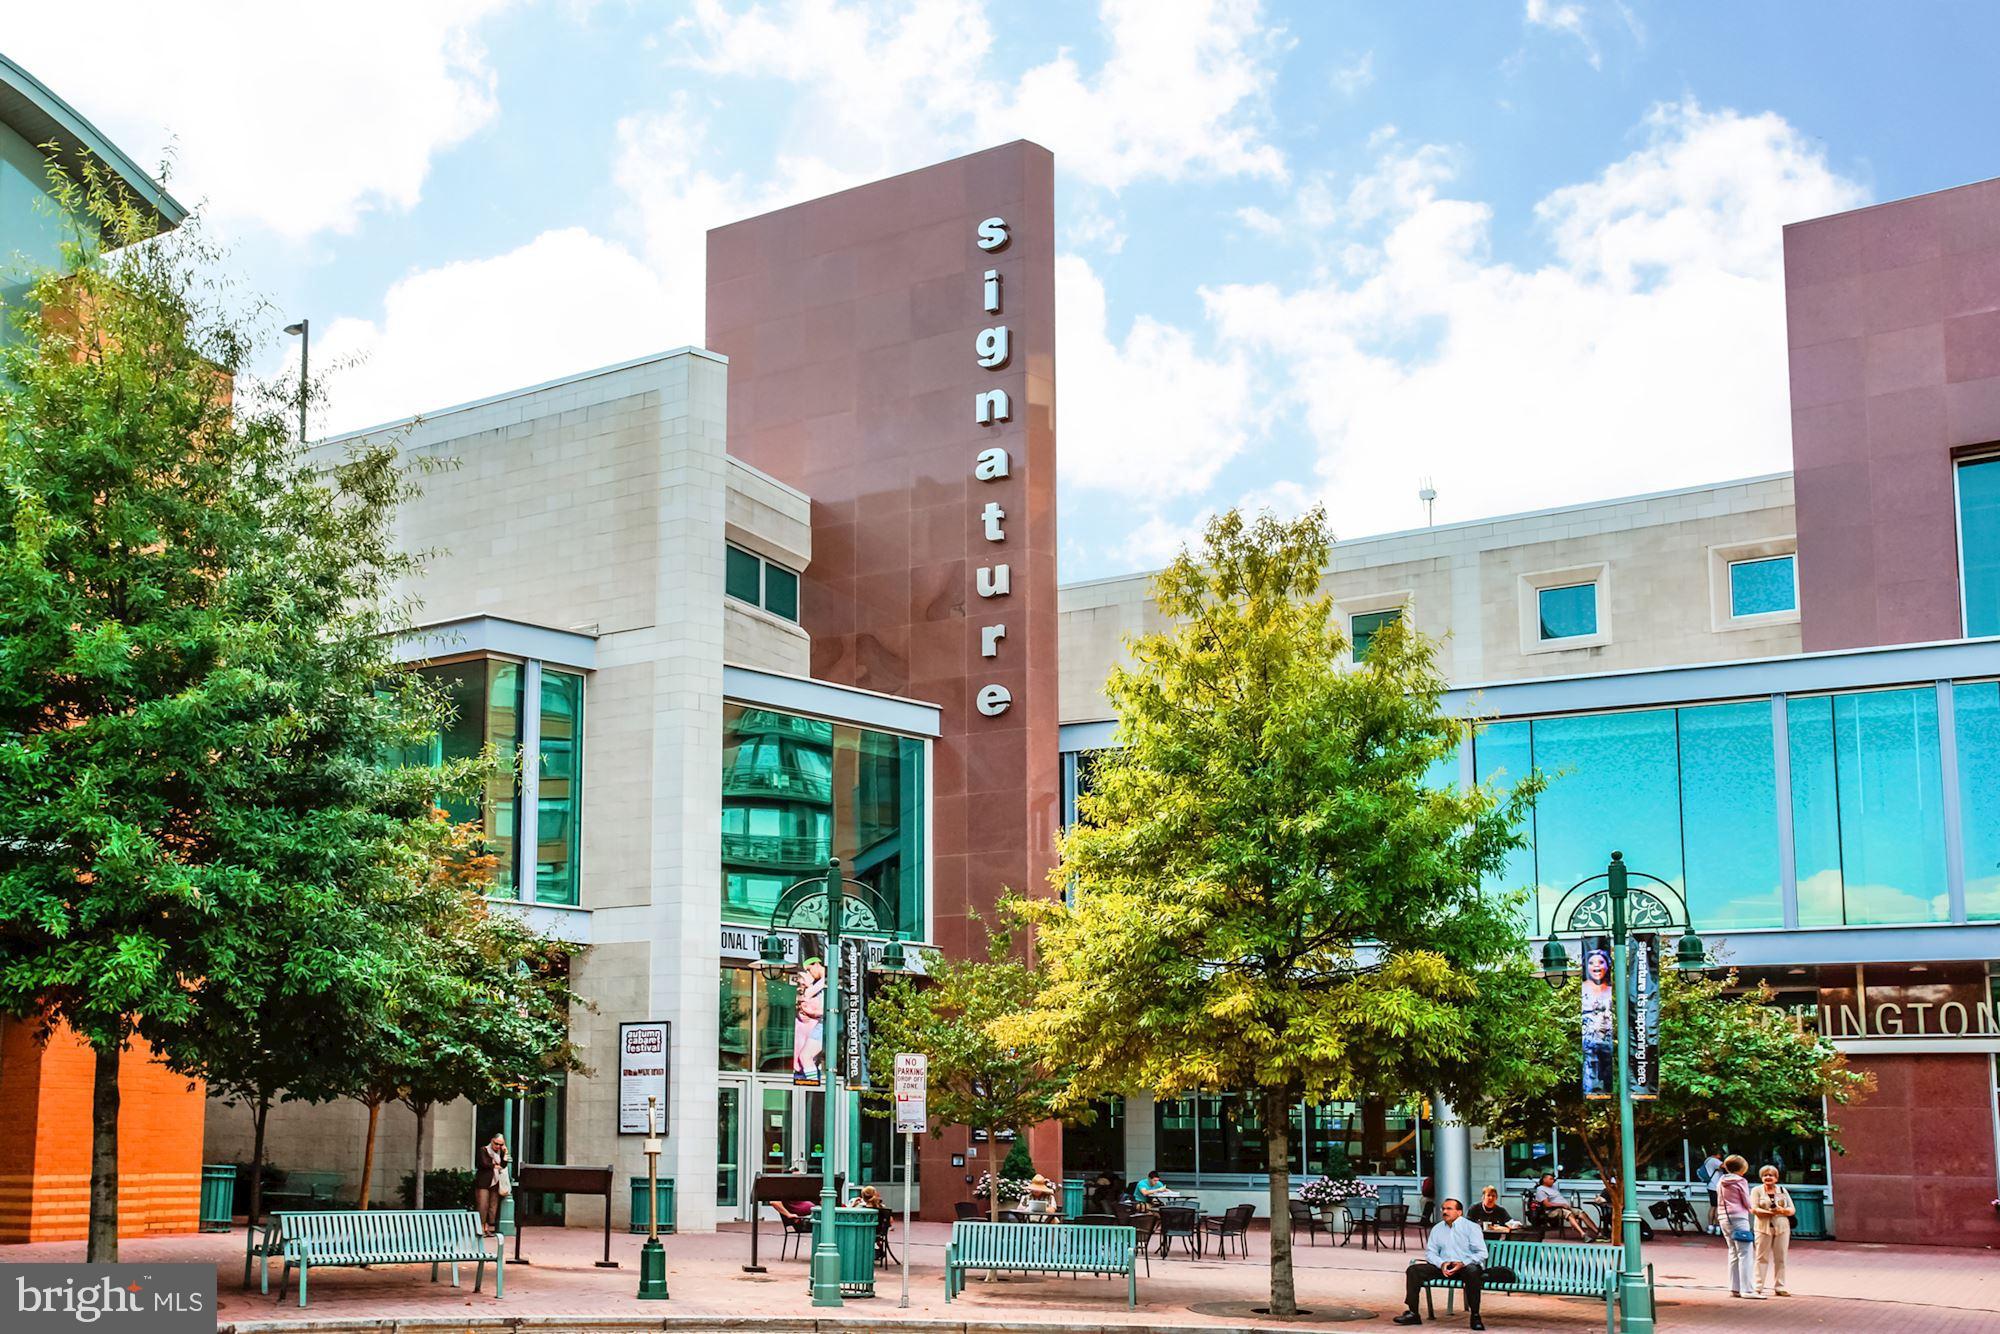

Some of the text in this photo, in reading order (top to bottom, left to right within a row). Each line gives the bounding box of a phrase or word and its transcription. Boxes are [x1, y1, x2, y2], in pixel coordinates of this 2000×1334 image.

[975, 217, 1011, 717] signature
[721, 932, 748, 950] ONAL
[848, 946, 861, 993] signature
[1637, 941, 1651, 992] signature
[849, 994, 859, 1008] it's
[1637, 993, 1648, 1007] it's
[627, 1030, 661, 1039] autumn
[848, 1008, 860, 1054] happening
[1635, 1008, 1648, 1060] happening
[627, 1037, 661, 1045] cabaret
[627, 1043, 661, 1053] festival
[850, 1055, 860, 1078] here.
[897, 1067, 924, 1076] PARKING
[905, 1058, 917, 1067] NO
[1637, 1061, 1648, 1085] here.
